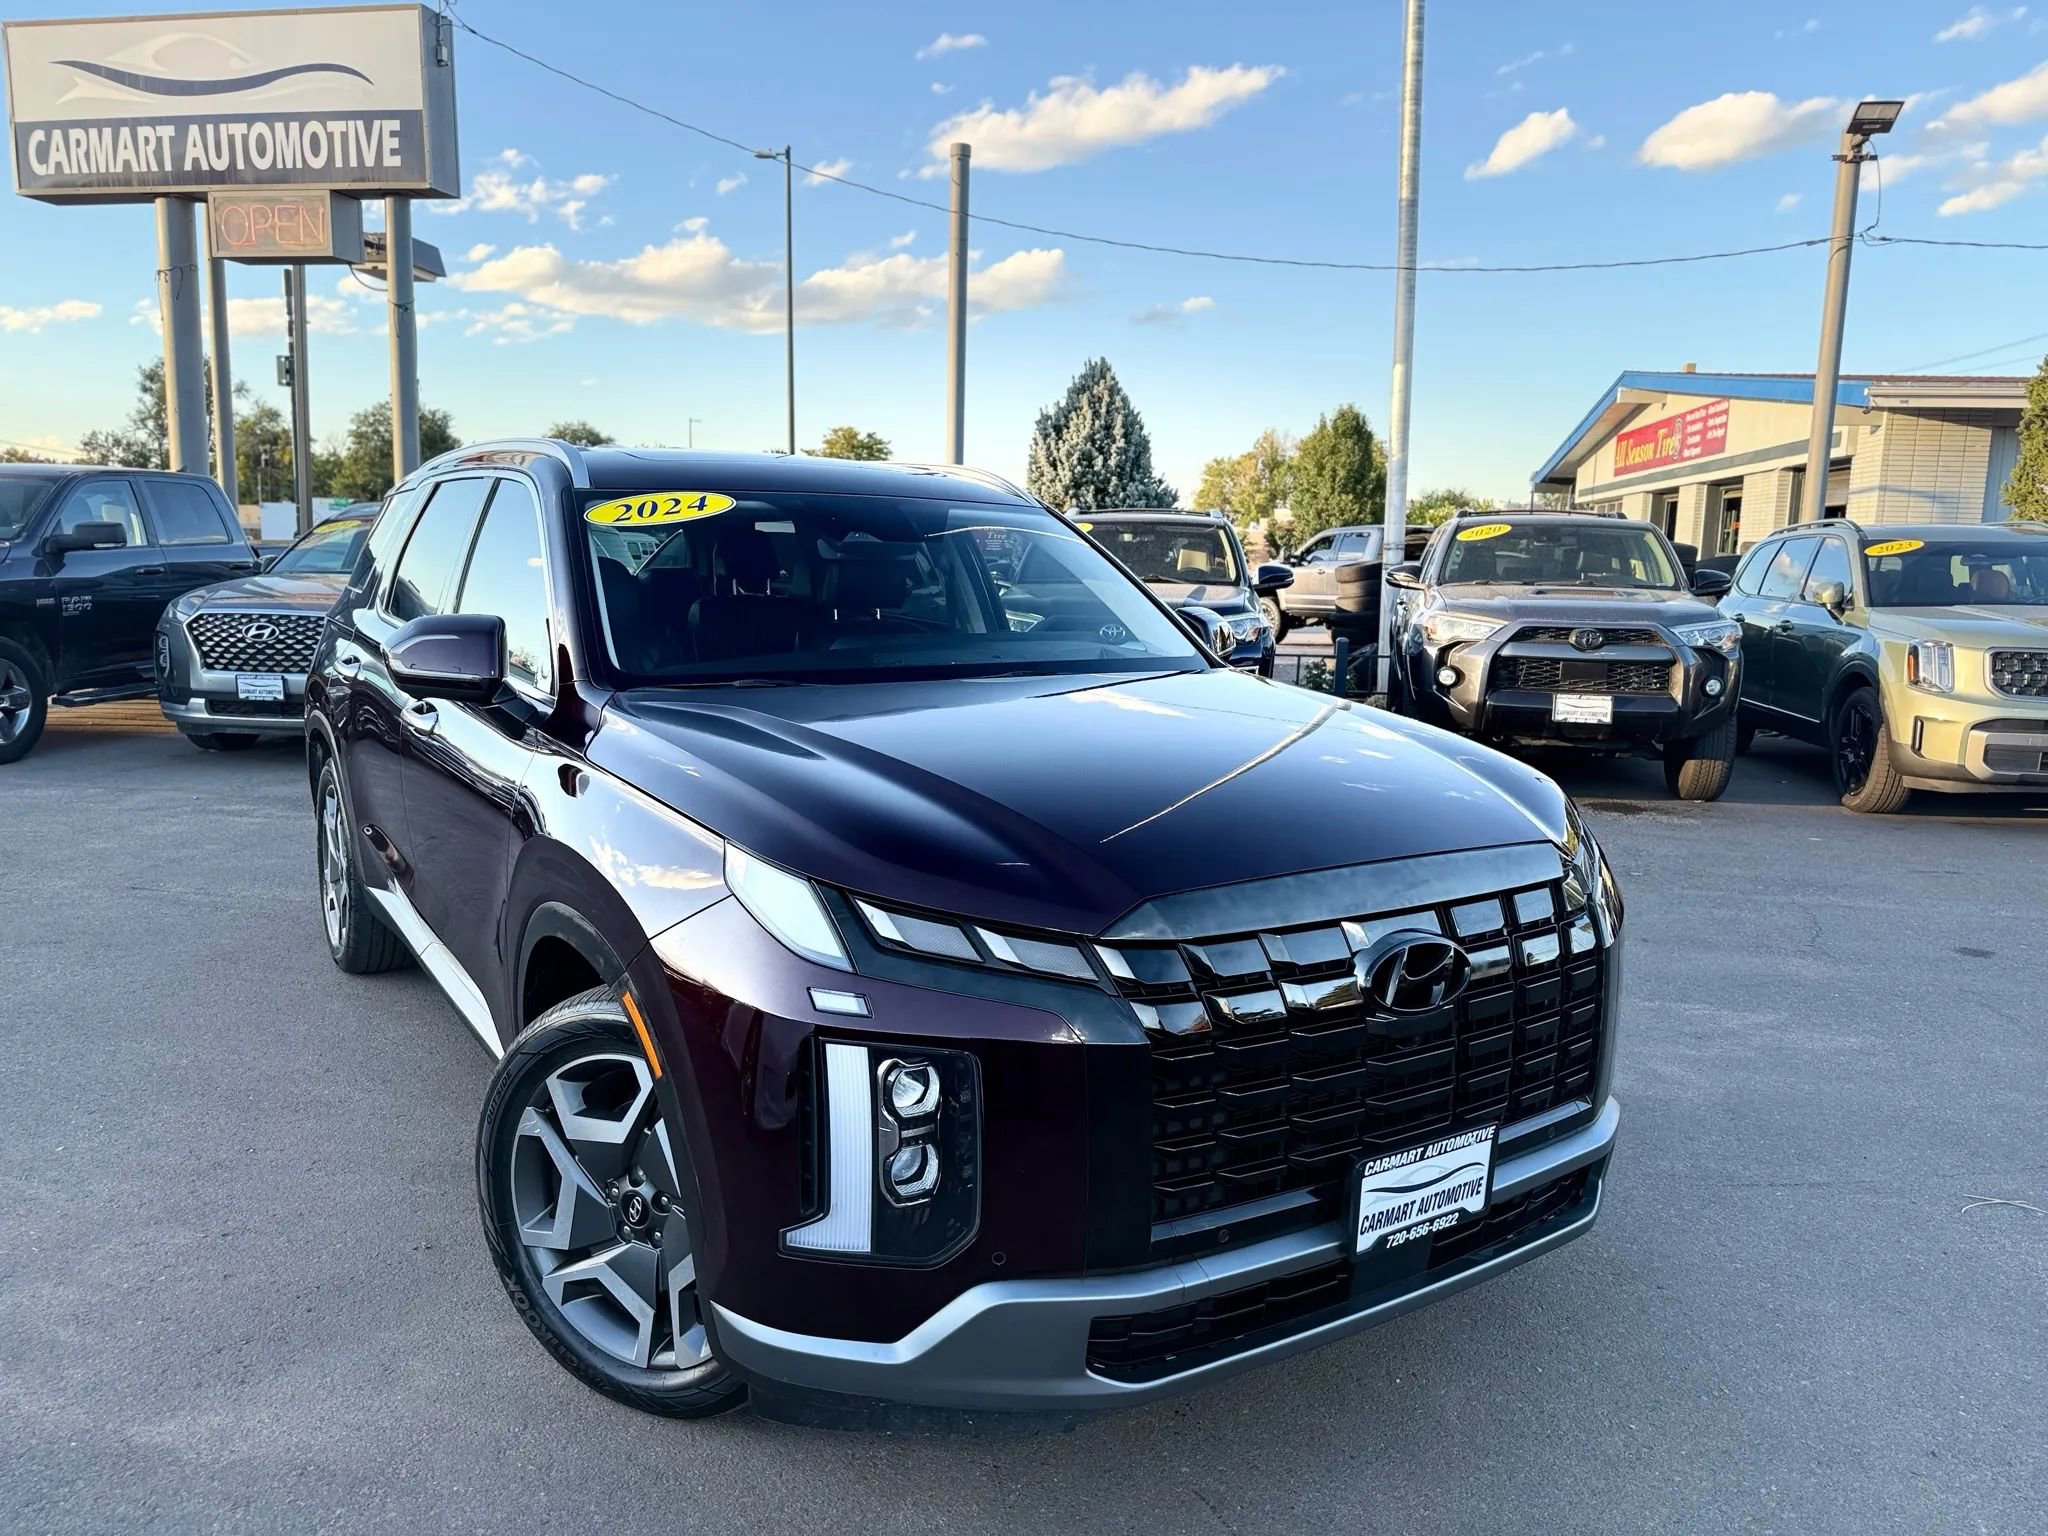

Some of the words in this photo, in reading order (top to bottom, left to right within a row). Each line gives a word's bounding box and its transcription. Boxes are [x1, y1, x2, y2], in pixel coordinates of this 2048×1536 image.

[28, 125, 176, 176] CARMART
[183, 119, 402, 172] AUTOMOTIVE
[220, 203, 326, 248] OPEN
[1615, 439, 1627, 469] All
[1626, 437, 1655, 467] Season
[612, 495, 708, 523] 2024
[1467, 526, 1502, 539] 2020
[1876, 541, 1914, 554] 2023
[486, 1068, 512, 1125] OUTSIDE
[1364, 1147, 1424, 1176] CARMART
[1424, 1125, 1496, 1159] AUTOMOTIVE
[1359, 1199, 1417, 1236] CARMART
[1416, 1175, 1485, 1217] AUTOMOTIVE
[1386, 1212, 1460, 1249] 720-656-6922
